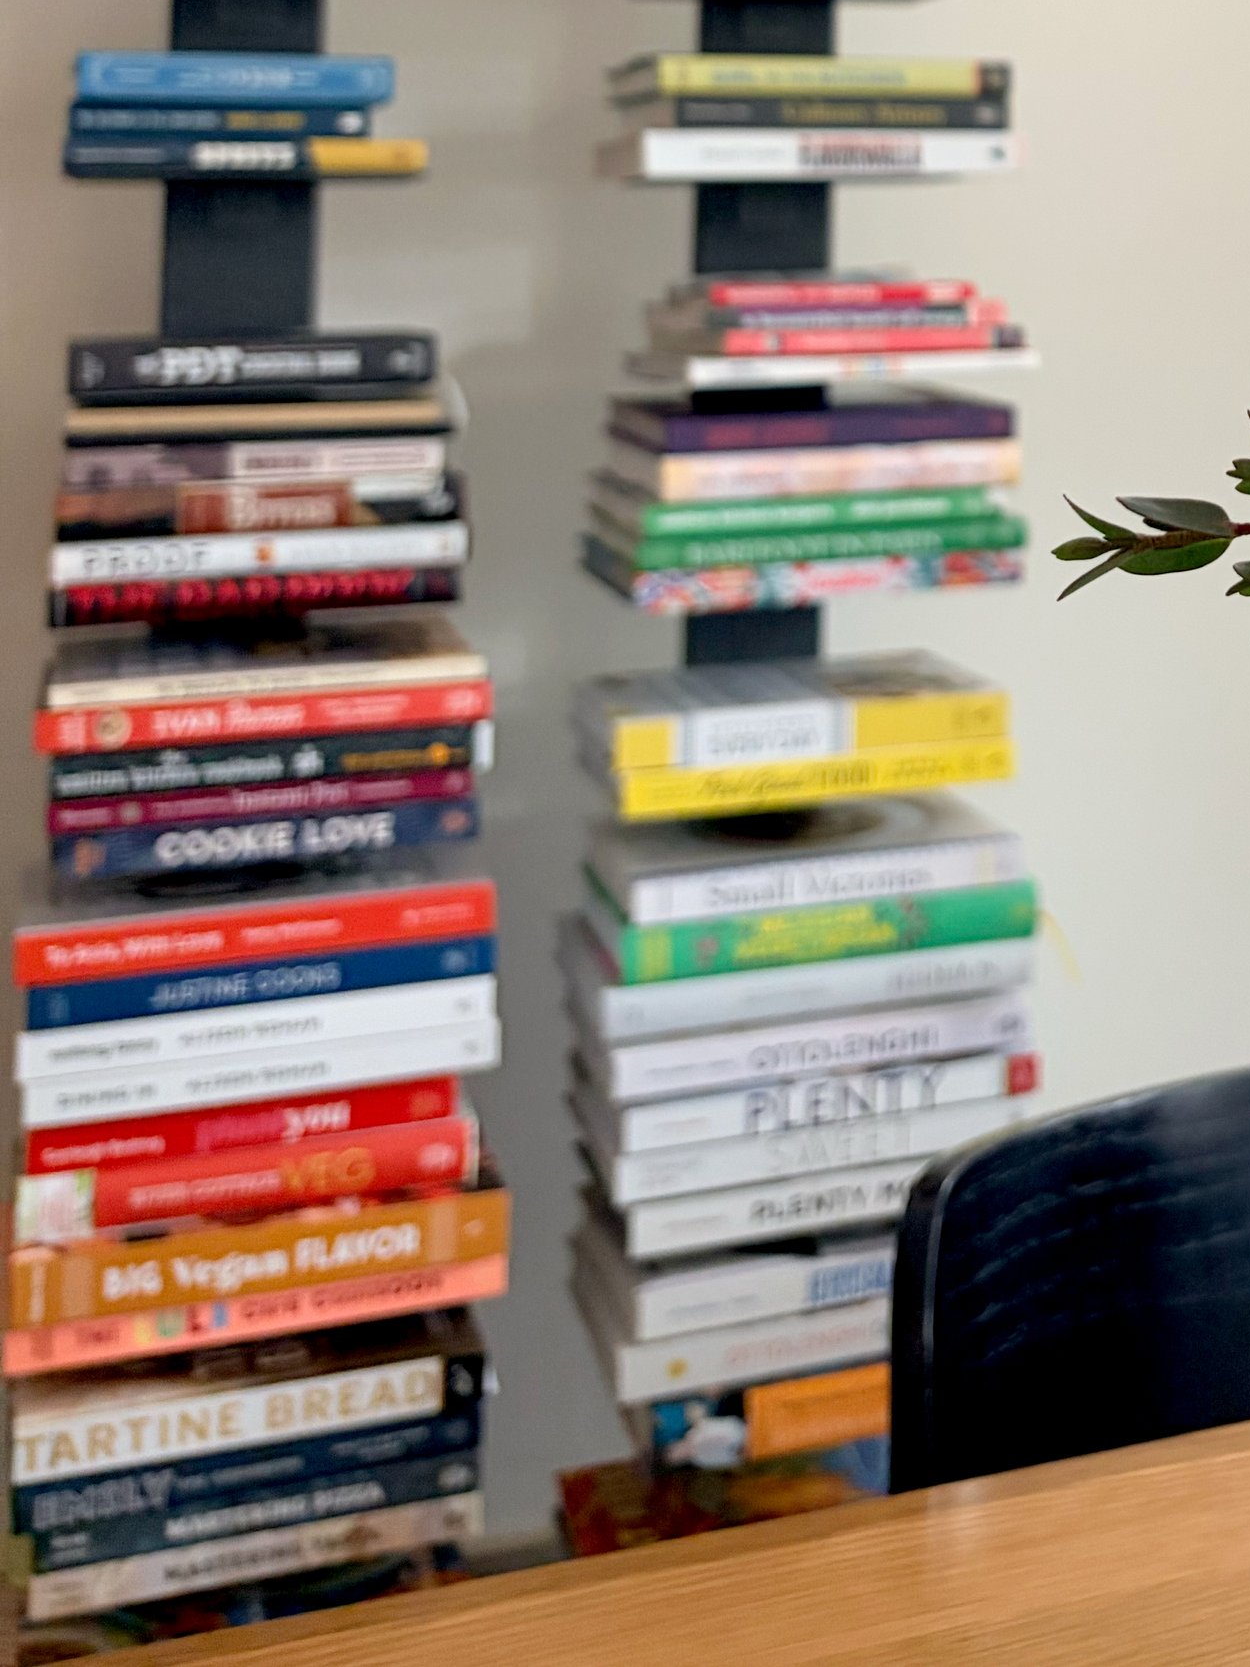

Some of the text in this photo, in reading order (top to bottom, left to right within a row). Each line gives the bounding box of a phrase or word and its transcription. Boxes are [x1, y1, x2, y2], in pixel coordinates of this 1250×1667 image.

[155, 811, 396, 868] COOKIE LOVE
[746, 1066, 945, 1134] PLENTY
[102, 1222, 421, 1300] BIG Vegan FLAVOR
[18, 1370, 440, 1470] TARTINE BREAD
